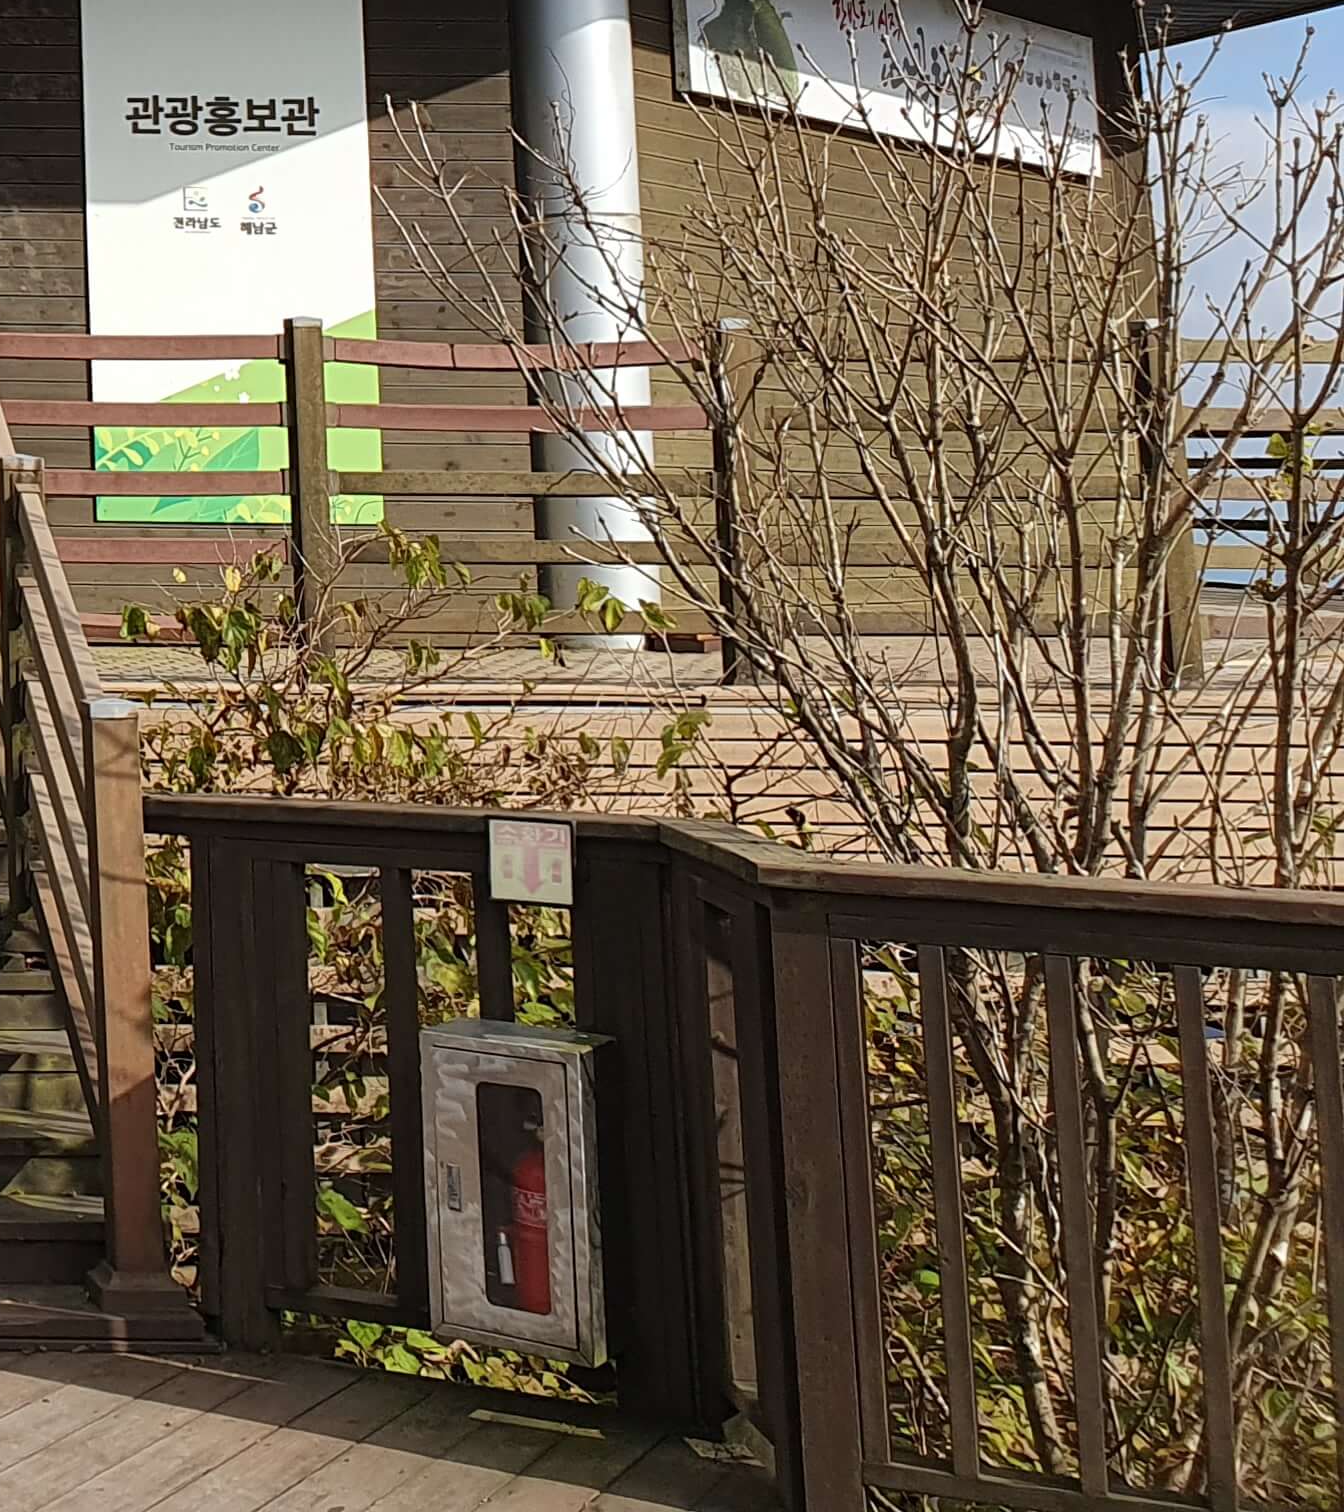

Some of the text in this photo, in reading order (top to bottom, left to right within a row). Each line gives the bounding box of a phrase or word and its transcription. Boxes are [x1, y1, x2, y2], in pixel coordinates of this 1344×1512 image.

[125, 94, 320, 137] 관광홍보관
[169, 142, 280, 152] Tourism Promotion Center
[173, 216, 222, 230] 전라남도
[240, 221, 278, 235] 해남군
[496, 823, 568, 844] 소화기
